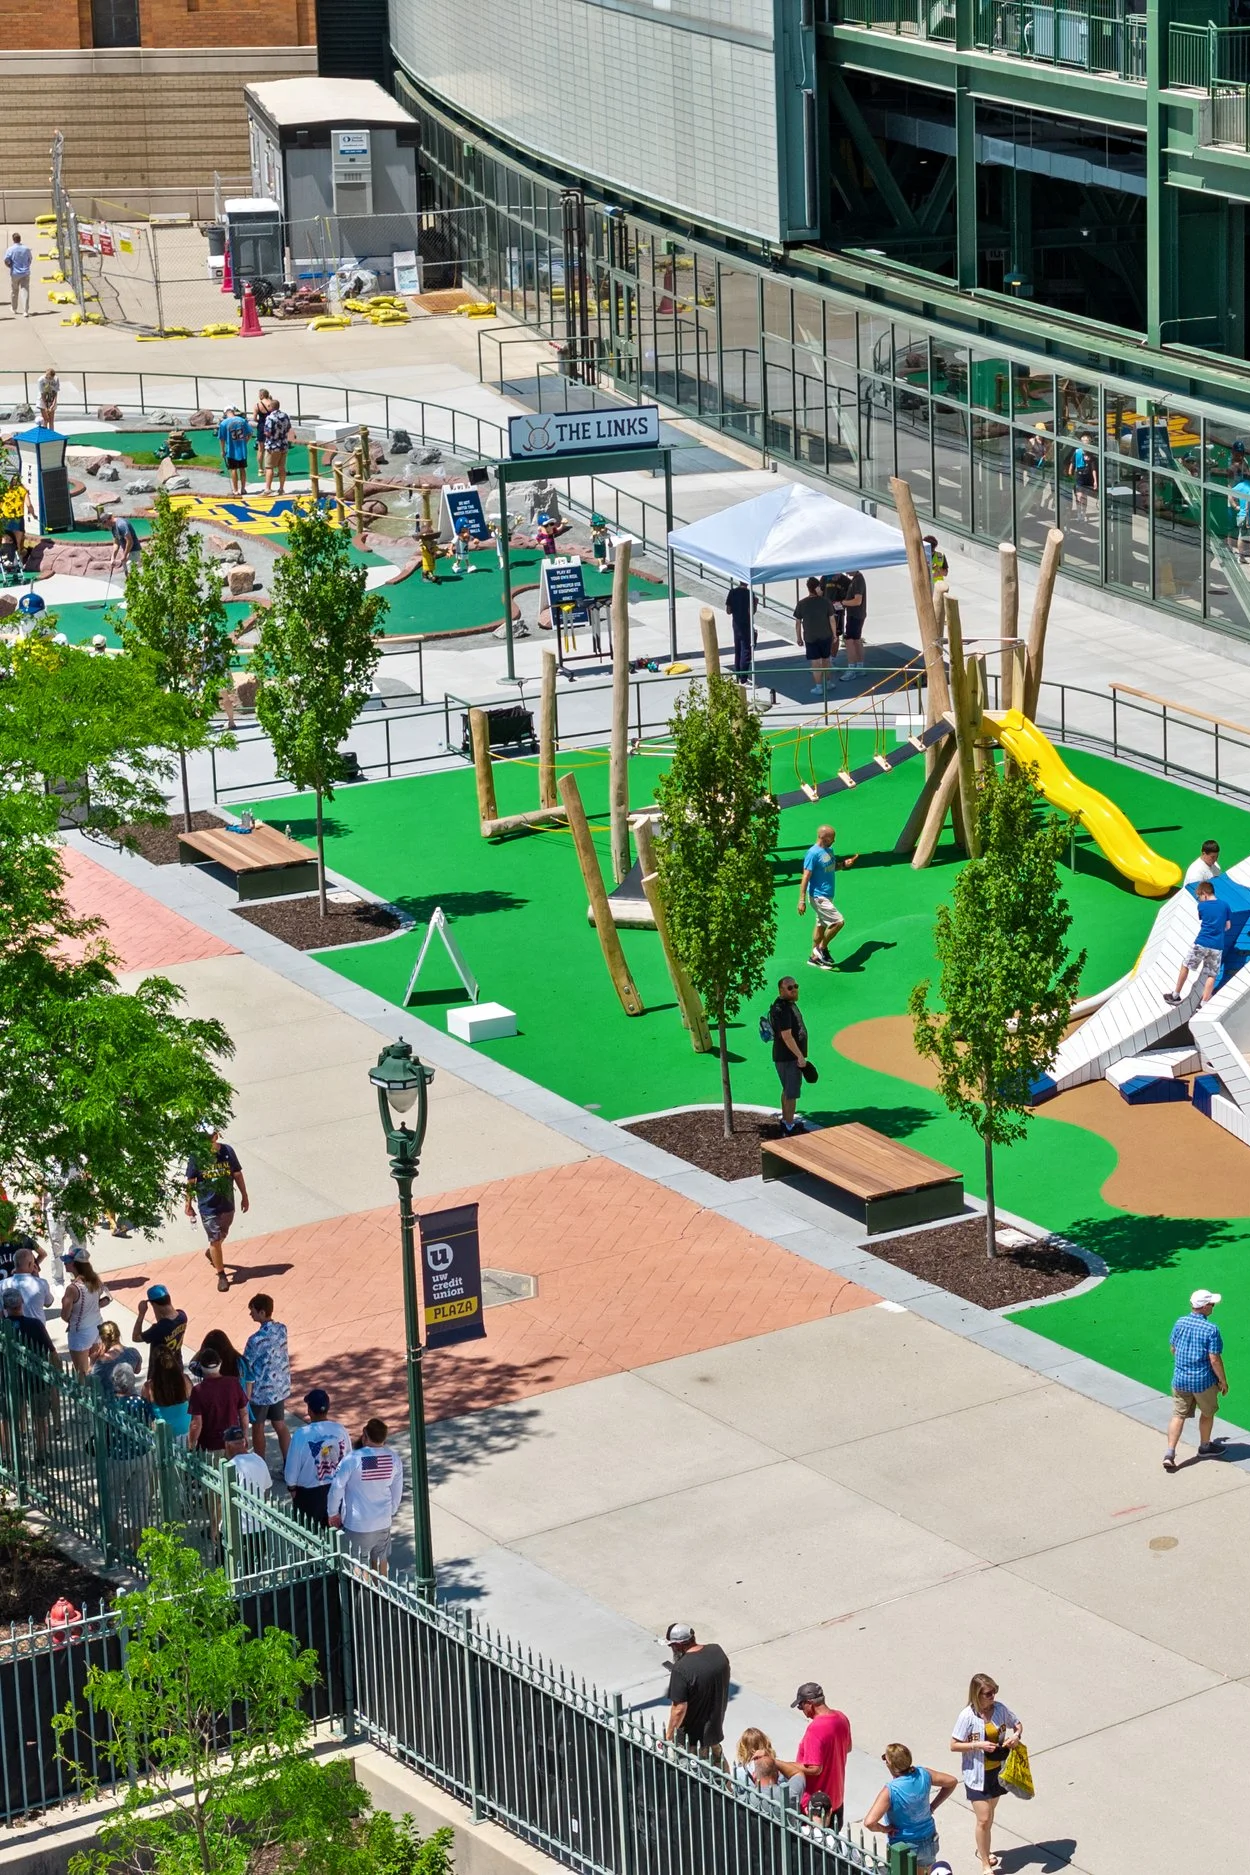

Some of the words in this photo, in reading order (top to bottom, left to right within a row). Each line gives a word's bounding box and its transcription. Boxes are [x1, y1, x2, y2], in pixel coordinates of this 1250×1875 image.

[555, 421, 592, 442] THE
[596, 416, 649, 439] LINKS
[431, 1272, 449, 1283] uw
[432, 1276, 463, 1291] credit
[432, 1286, 465, 1300] union
[433, 1300, 473, 1320] PLAZA
